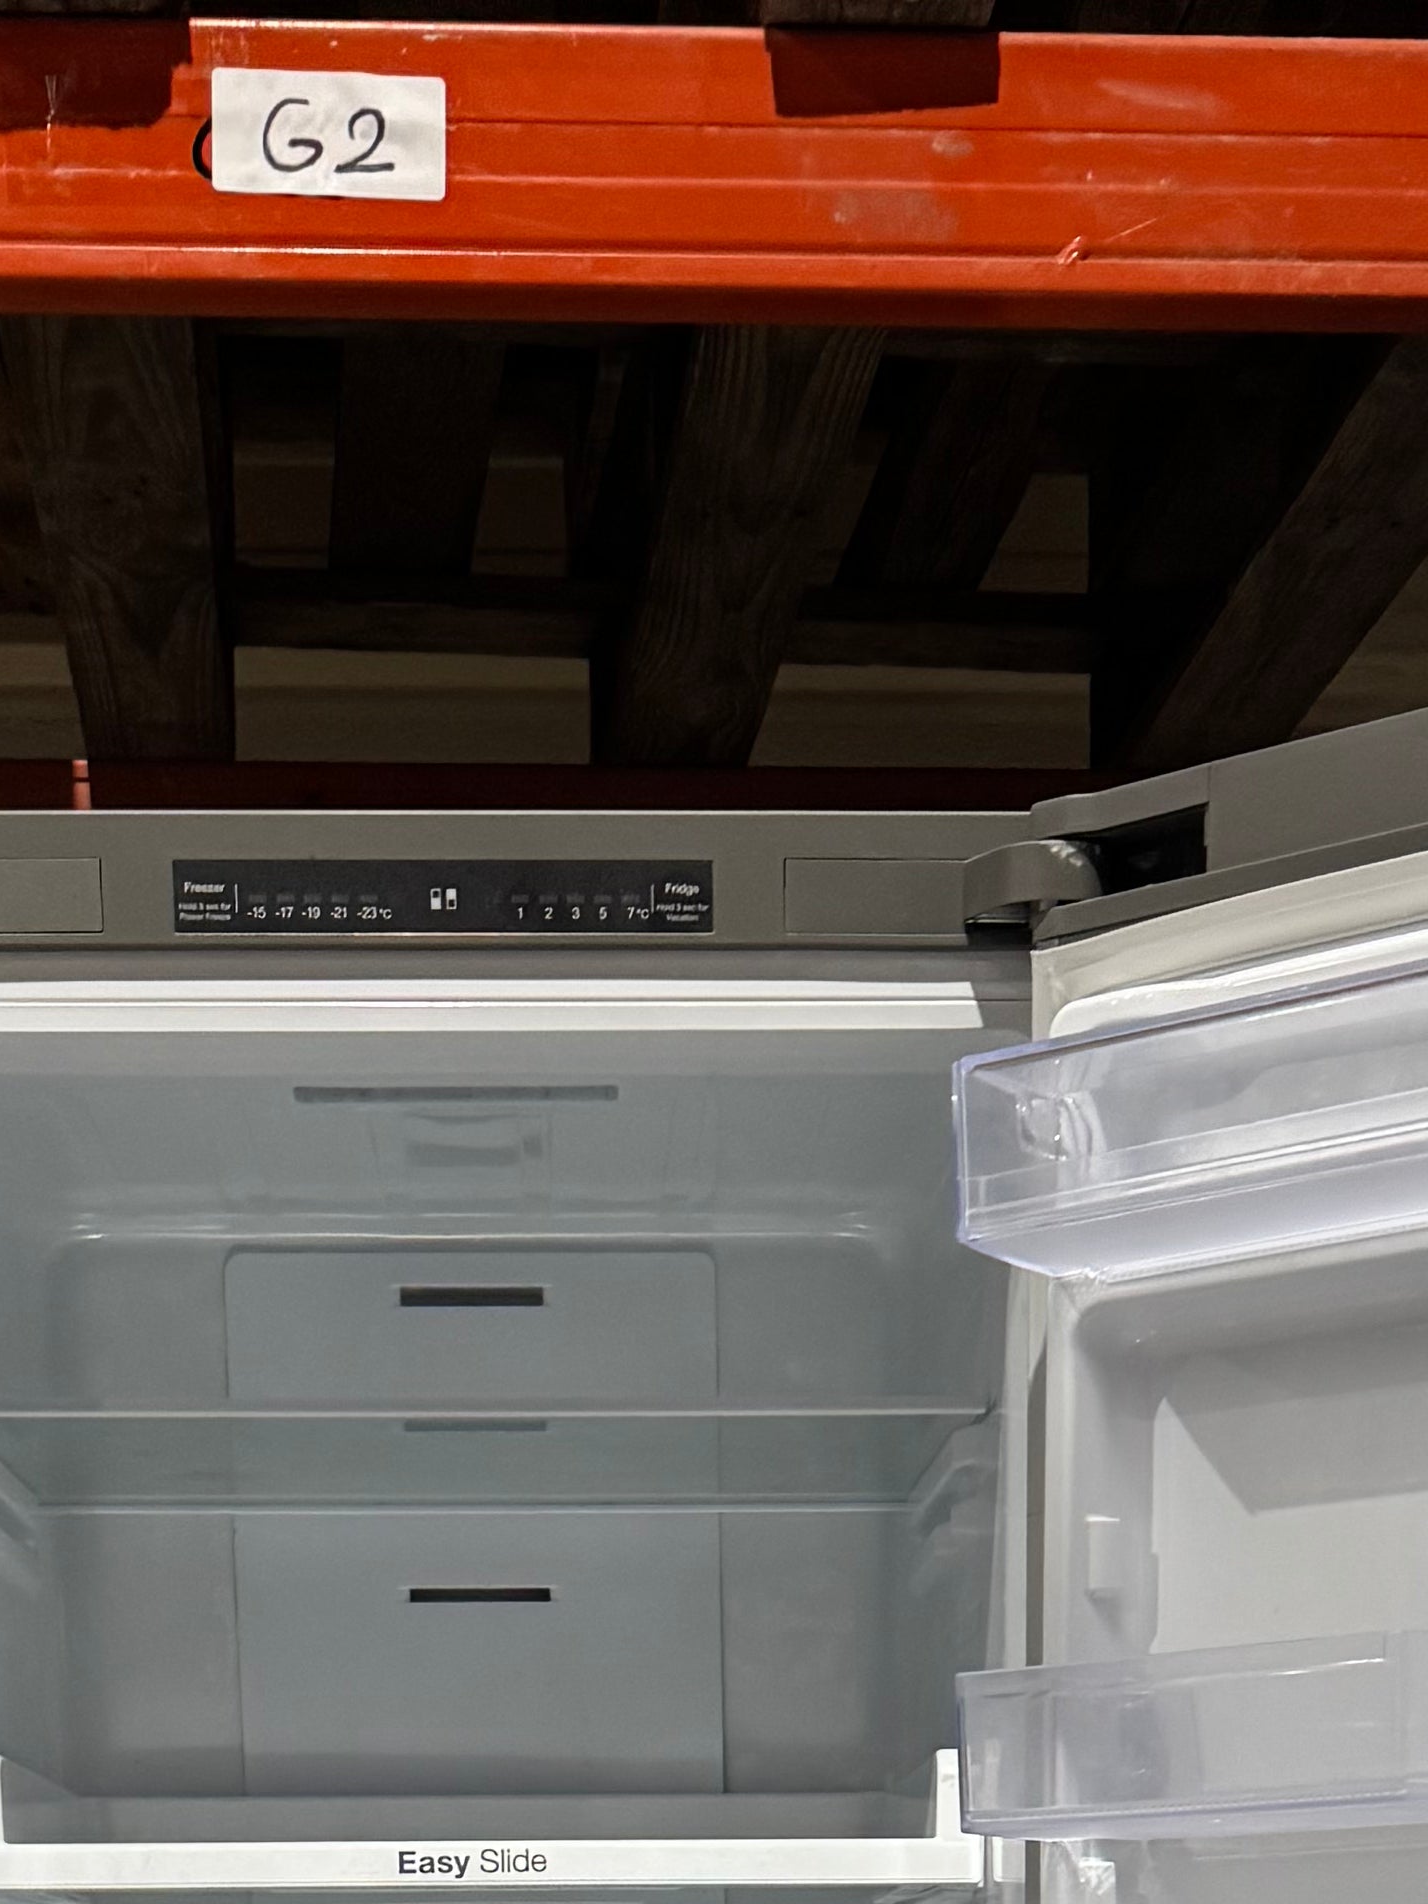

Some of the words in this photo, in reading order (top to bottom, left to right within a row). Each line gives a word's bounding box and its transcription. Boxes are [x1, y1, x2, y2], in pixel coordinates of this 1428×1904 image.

[261, 97, 396, 174] G2
[664, 882, 700, 897] Fridge
[247, 905, 267, 920] -15
[275, 905, 294, 919] -17
[301, 905, 322, 919] -19
[330, 905, 348, 919] -21
[544, 906, 554, 920] 2
[571, 906, 581, 920] 3
[598, 906, 608, 920] 5
[397, 1850, 471, 1879] Easy
[479, 1848, 548, 1874] Slide
